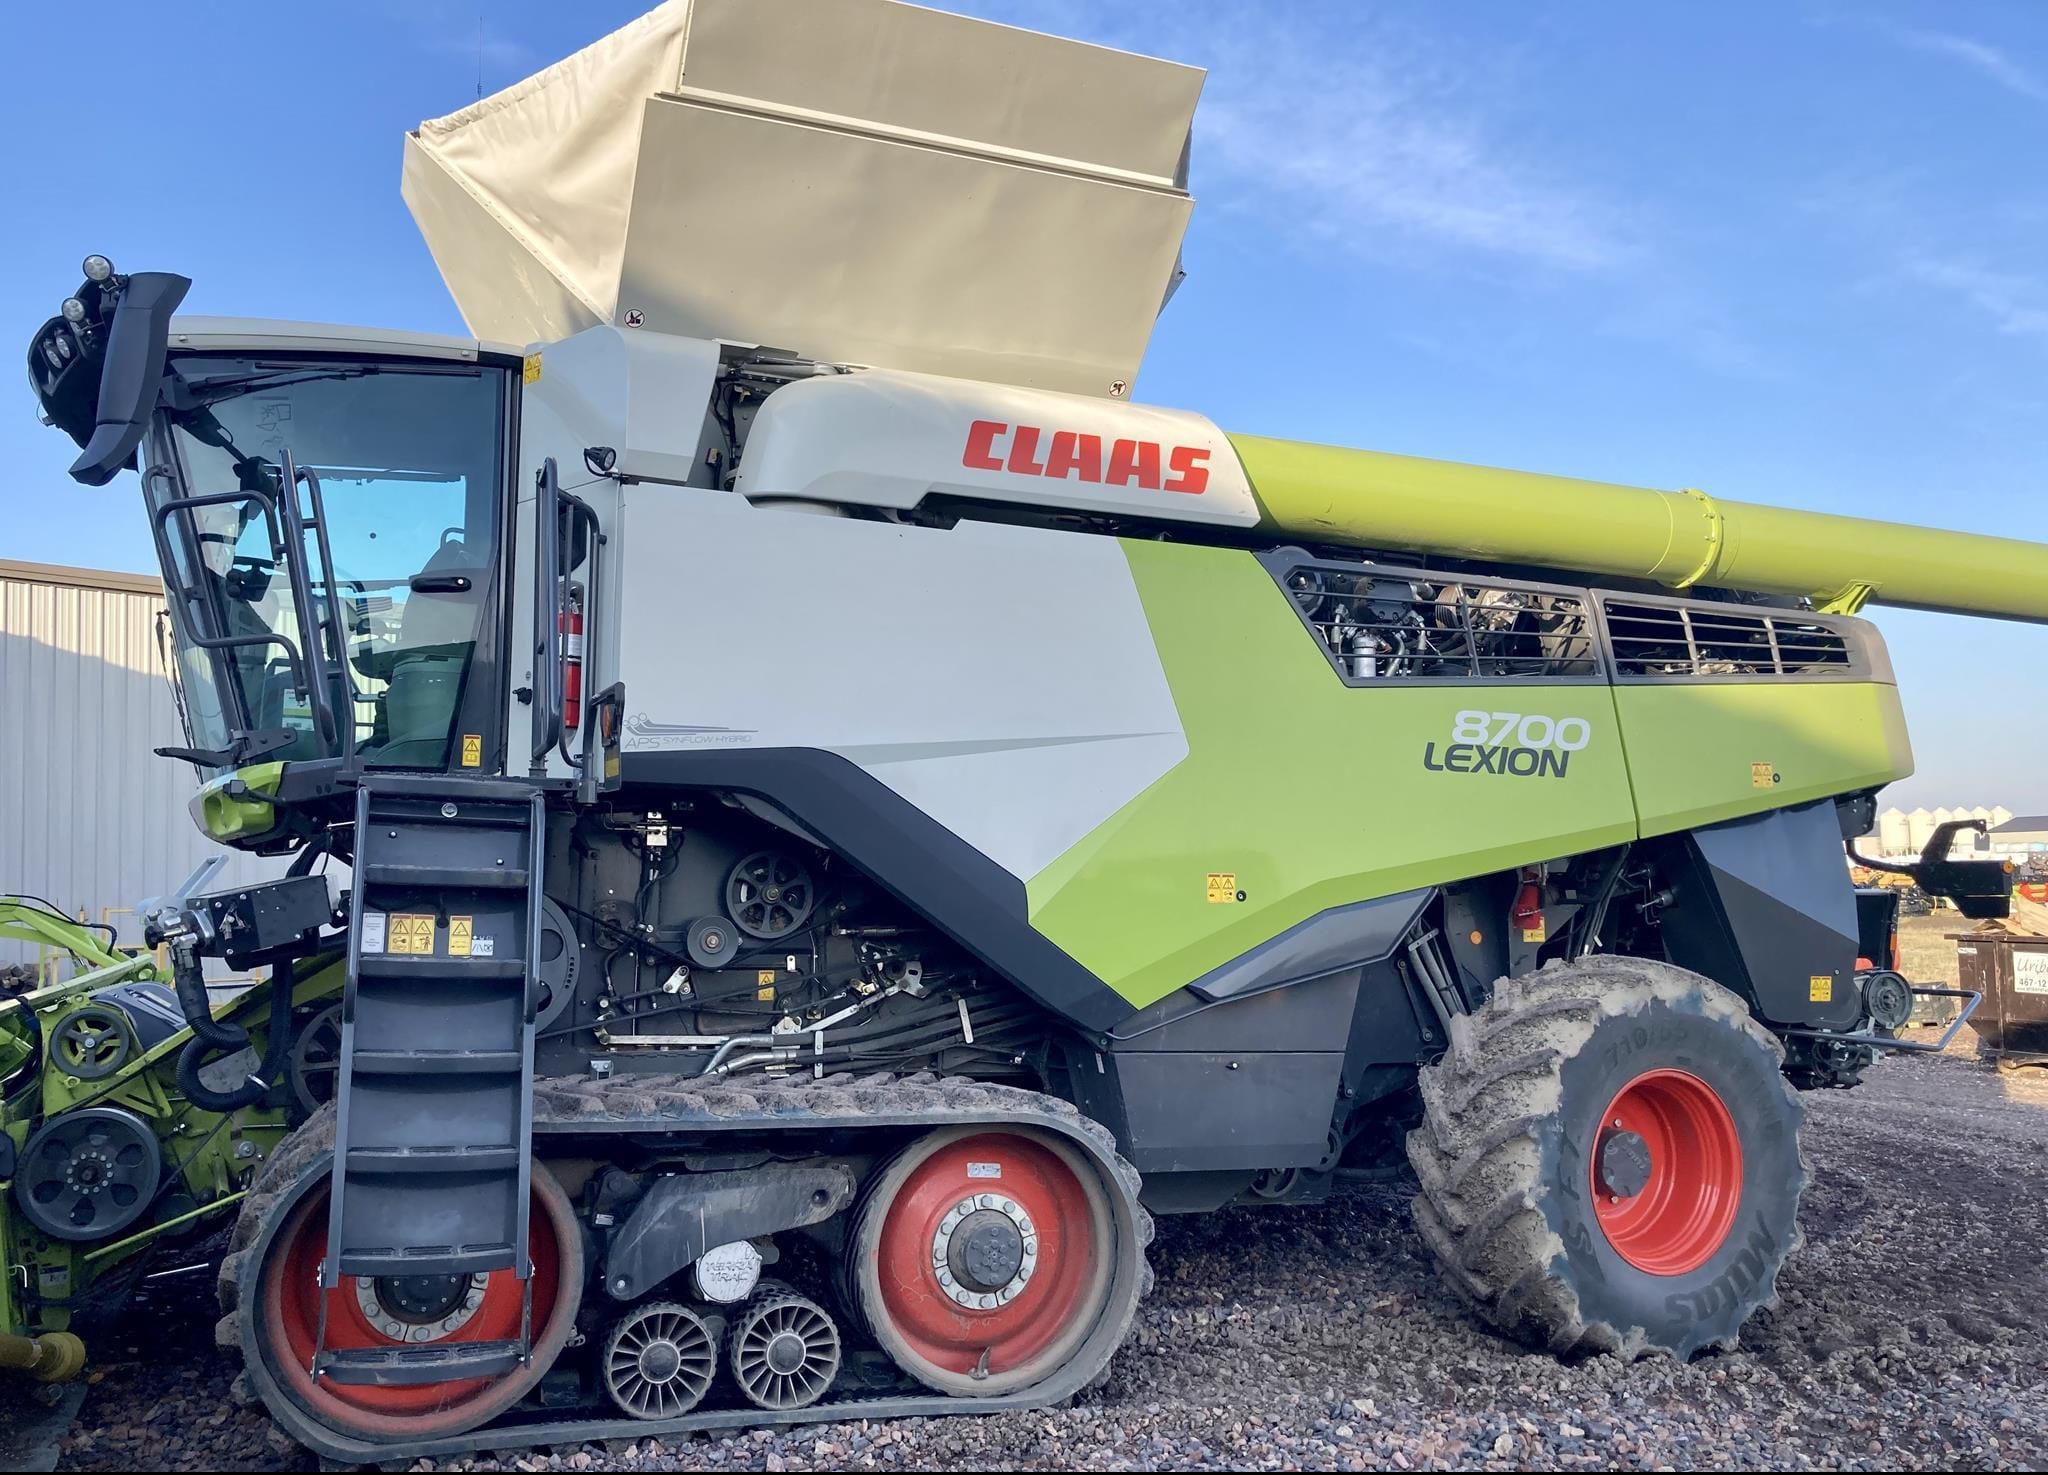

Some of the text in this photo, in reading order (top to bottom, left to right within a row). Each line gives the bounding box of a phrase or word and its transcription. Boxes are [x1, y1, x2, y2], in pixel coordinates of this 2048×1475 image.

[962, 420, 1211, 495] CLAAS
[625, 737, 660, 749] APS
[1452, 710, 1591, 750] 8700
[1424, 742, 1570, 778] LEXION
